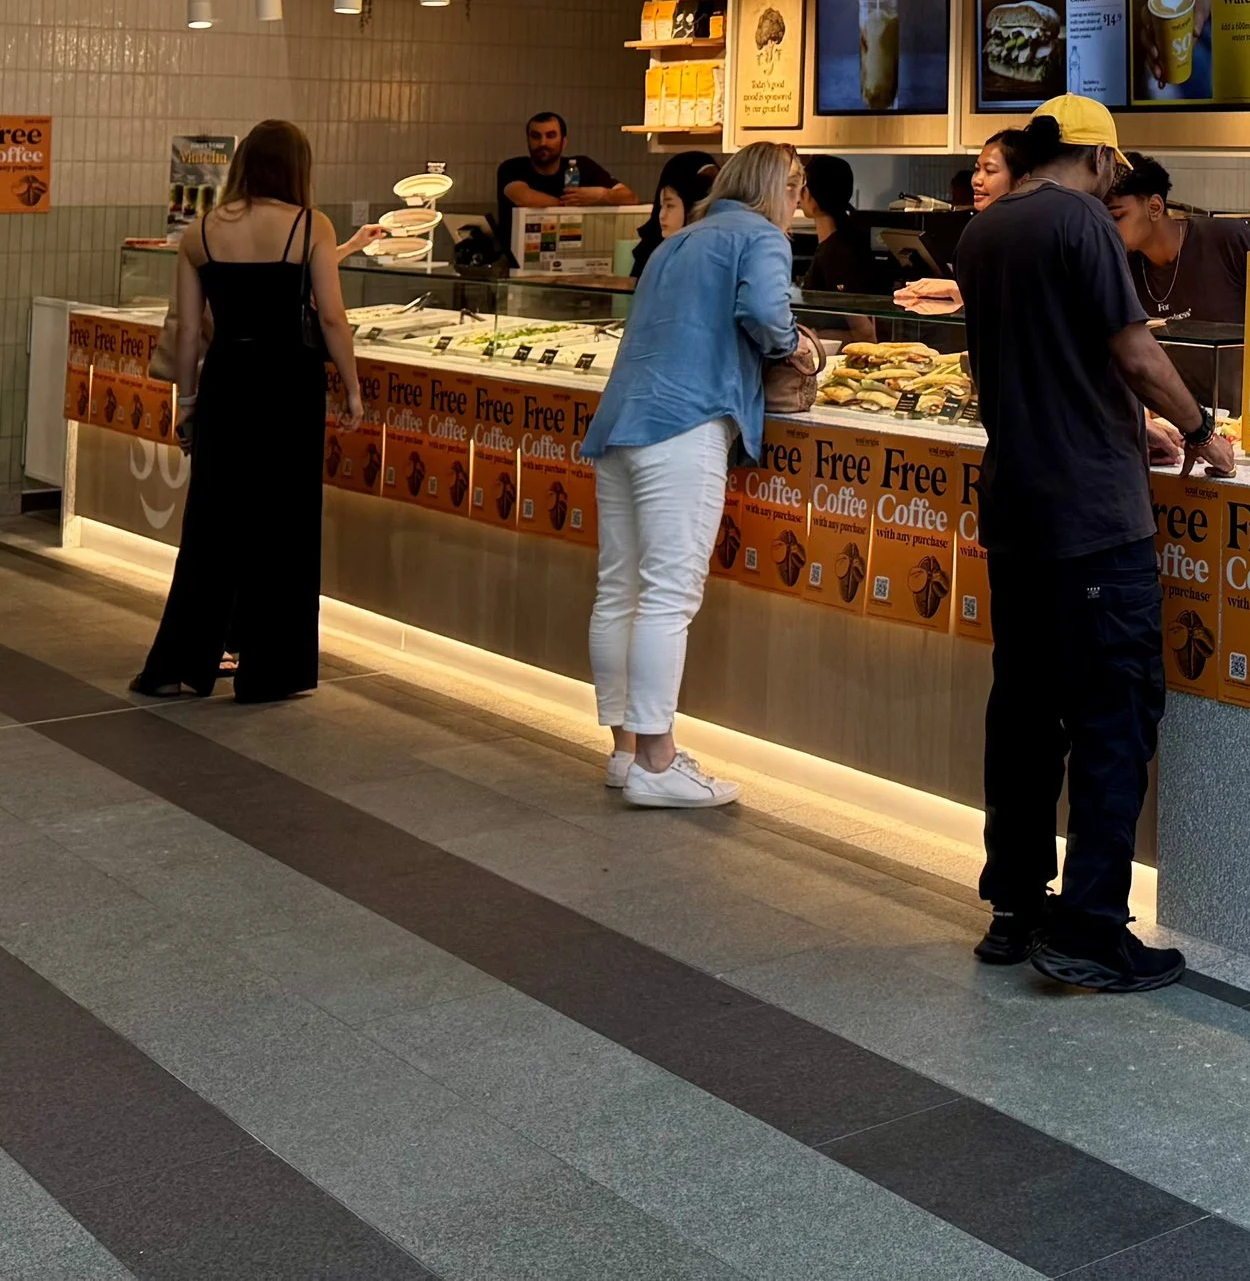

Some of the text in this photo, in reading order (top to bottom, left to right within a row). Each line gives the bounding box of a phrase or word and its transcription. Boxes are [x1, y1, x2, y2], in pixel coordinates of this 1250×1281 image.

[70, 320, 90, 348] Free
[94, 324, 116, 352] Free
[120, 328, 143, 358] Free
[118, 356, 143, 378] Coffee
[388, 372, 422, 408] Free
[430, 379, 467, 416] Free
[386, 407, 422, 433] Coffee
[476, 387, 514, 426] Free
[523, 396, 565, 432] Free
[428, 414, 467, 442] Coffee
[474, 423, 514, 453] Coffee
[522, 432, 565, 462] Coffee
[760, 442, 802, 475] ree
[815, 440, 870, 485] Free
[881, 448, 947, 496] Free
[746, 472, 802, 508] Coffee
[813, 483, 868, 519] Coffee
[877, 494, 948, 532] Coffee
[1152, 502, 1208, 542] ree
[876, 528, 895, 540] with
[896, 532, 912, 546] any
[960, 545, 978, 559] with
[1228, 596, 1250, 610] with
